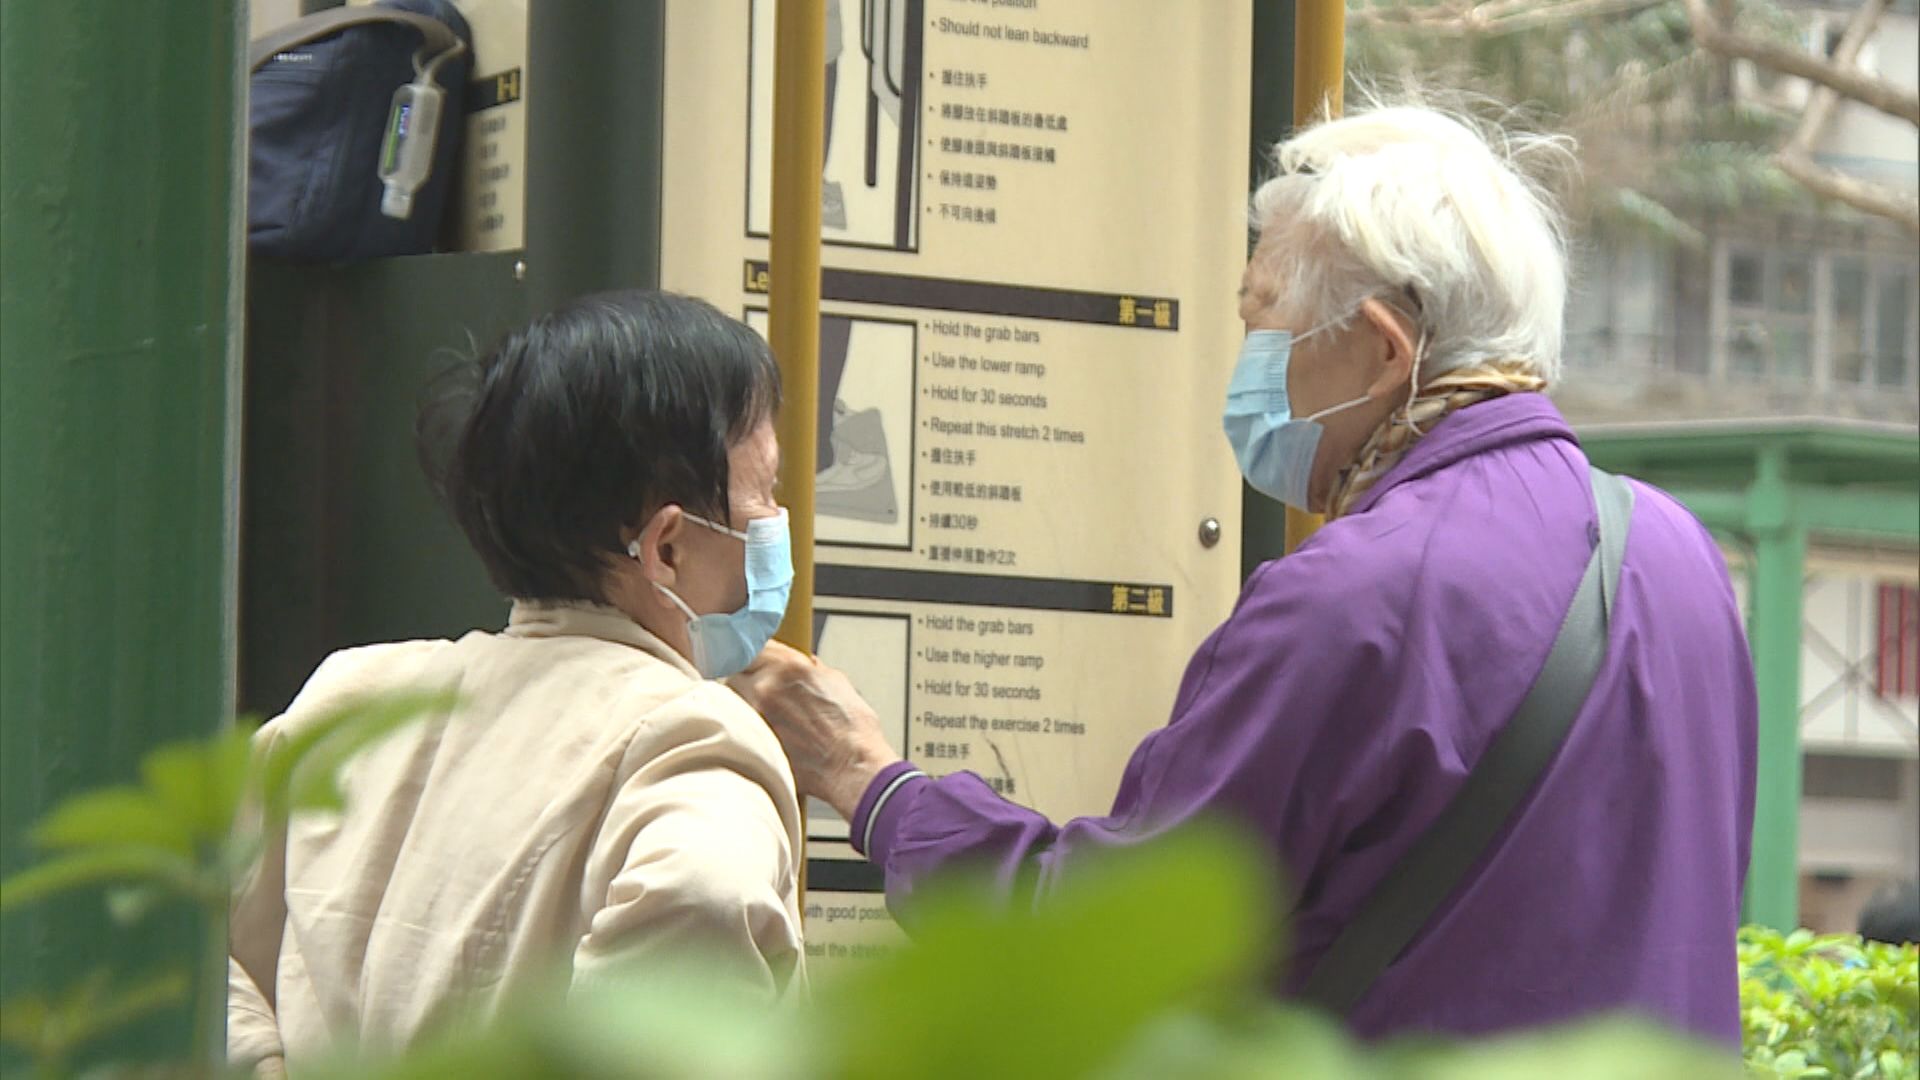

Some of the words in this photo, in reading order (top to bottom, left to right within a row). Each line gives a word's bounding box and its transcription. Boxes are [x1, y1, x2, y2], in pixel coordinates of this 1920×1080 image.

[939, 17, 979, 36] Should
[983, 26, 1000, 39] not
[1005, 24, 1029, 42] lean
[1033, 28, 1089, 48] backward
[1119, 294, 1170, 328] 第一級
[932, 320, 960, 337] Hold
[963, 323, 981, 338] the
[985, 325, 1011, 343] grab
[1014, 326, 1040, 343] bars
[931, 352, 955, 369] Use
[959, 354, 977, 371] the
[980, 356, 1011, 373] lower
[1015, 362, 1045, 378] ramp
[931, 384, 959, 401] Hold
[962, 386, 978, 402] for
[981, 388, 996, 404] 30
[999, 392, 1047, 409] seconds
[931, 417, 973, 437] Repeat
[976, 420, 997, 437] this
[1000, 421, 1039, 440] stretch
[1042, 425, 1051, 441] 2
[1053, 426, 1084, 443] times
[1112, 584, 1164, 614] 第二級
[926, 615, 953, 631] Hold
[956, 616, 975, 632] the
[978, 618, 1005, 636] grab
[1008, 619, 1034, 636] bars
[925, 647, 949, 664] Use
[952, 648, 970, 665] the
[974, 650, 1010, 668] higher
[1013, 655, 1044, 671] ramp
[924, 679, 952, 696] Hold
[955, 680, 971, 697] for
[974, 682, 989, 698] 30
[992, 684, 1041, 700] seconds
[924, 711, 967, 731] Repeat
[969, 714, 988, 731] the
[991, 717, 1040, 733] exercise
[1043, 717, 1051, 733] 2
[1054, 719, 1085, 735] times
[827, 905, 856, 923] good
